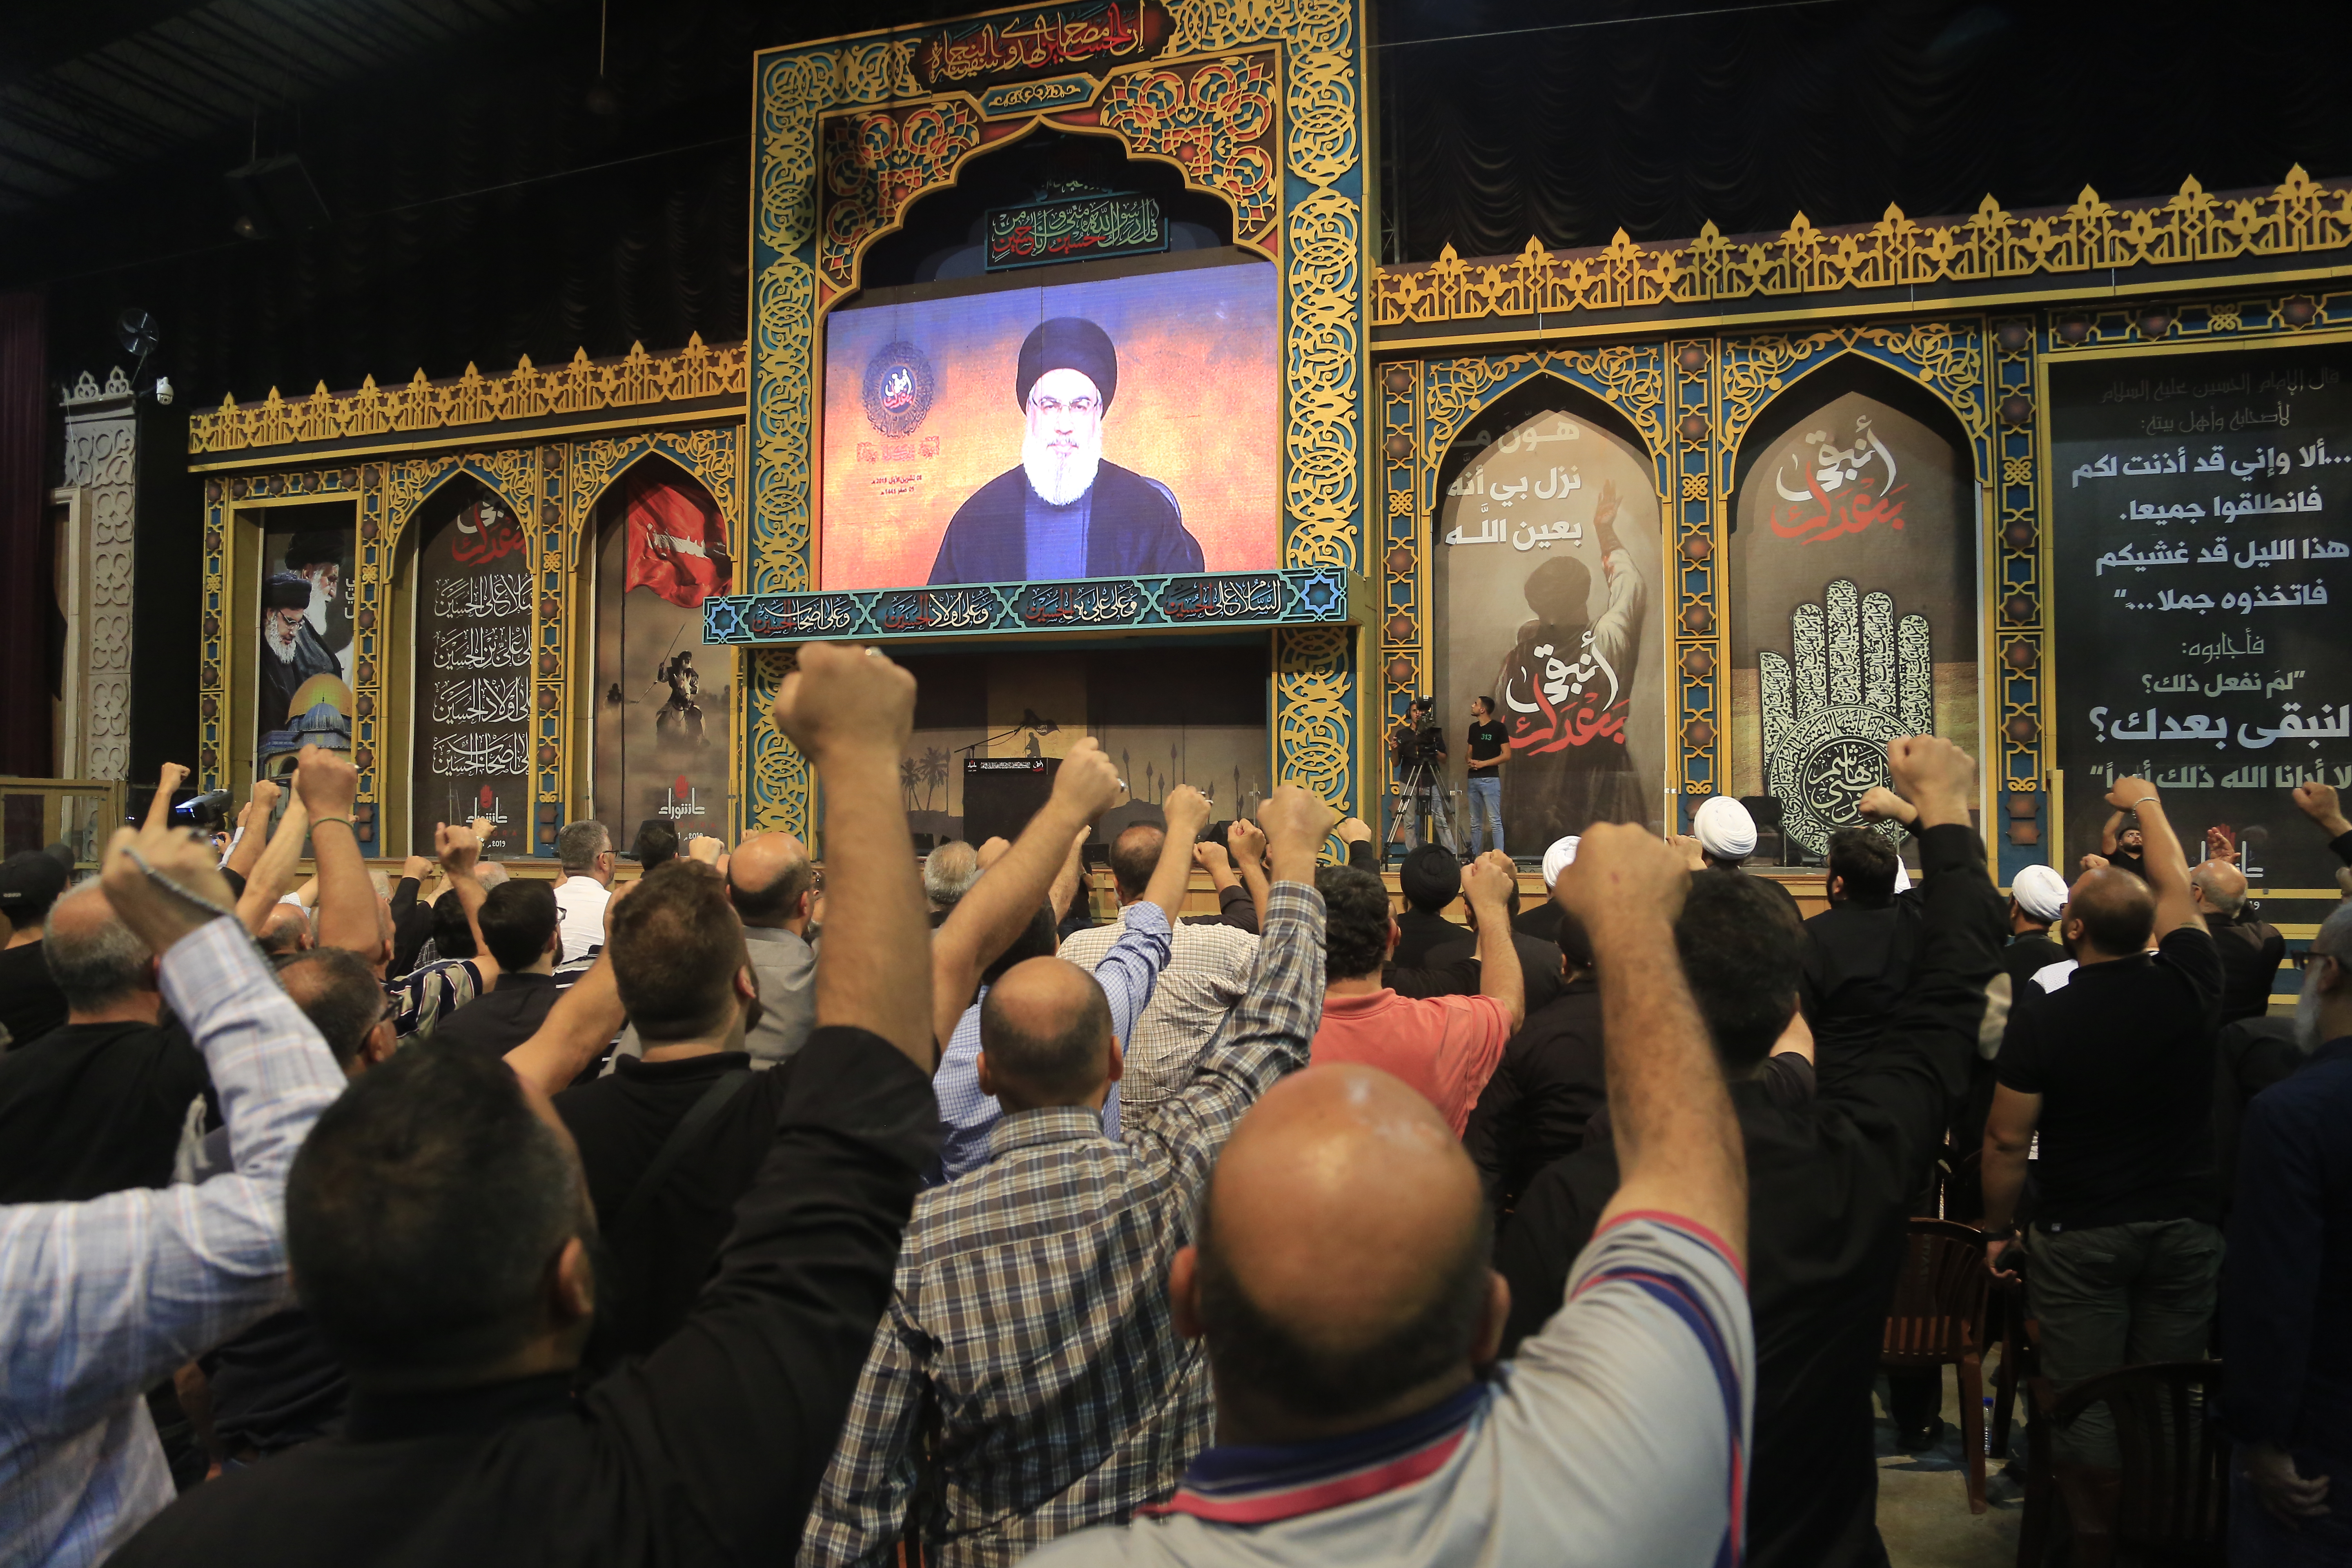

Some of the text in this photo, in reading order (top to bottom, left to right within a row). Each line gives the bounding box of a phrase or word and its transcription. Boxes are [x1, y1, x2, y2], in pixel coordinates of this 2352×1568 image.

[2072, 454, 2118, 488] لكم
[2123, 446, 2186, 475] أذنت
[2194, 445, 2225, 472] قد
[1490, 476, 1528, 508] بي
[1534, 465, 1581, 499] نزل
[2214, 485, 2323, 523] فانطلقوا
[1512, 521, 1582, 551] بعين
[2096, 537, 2350, 577] هذا الليل قد غشيكم
[2221, 579, 2328, 614] فاتخذوه
[2142, 674, 2199, 694] ذلك؟
[2204, 672, 2262, 698] نفعل
[2089, 706, 2228, 750] بعدك؟
[2156, 765, 2215, 789] ذلك
[2221, 765, 2268, 789] الله
